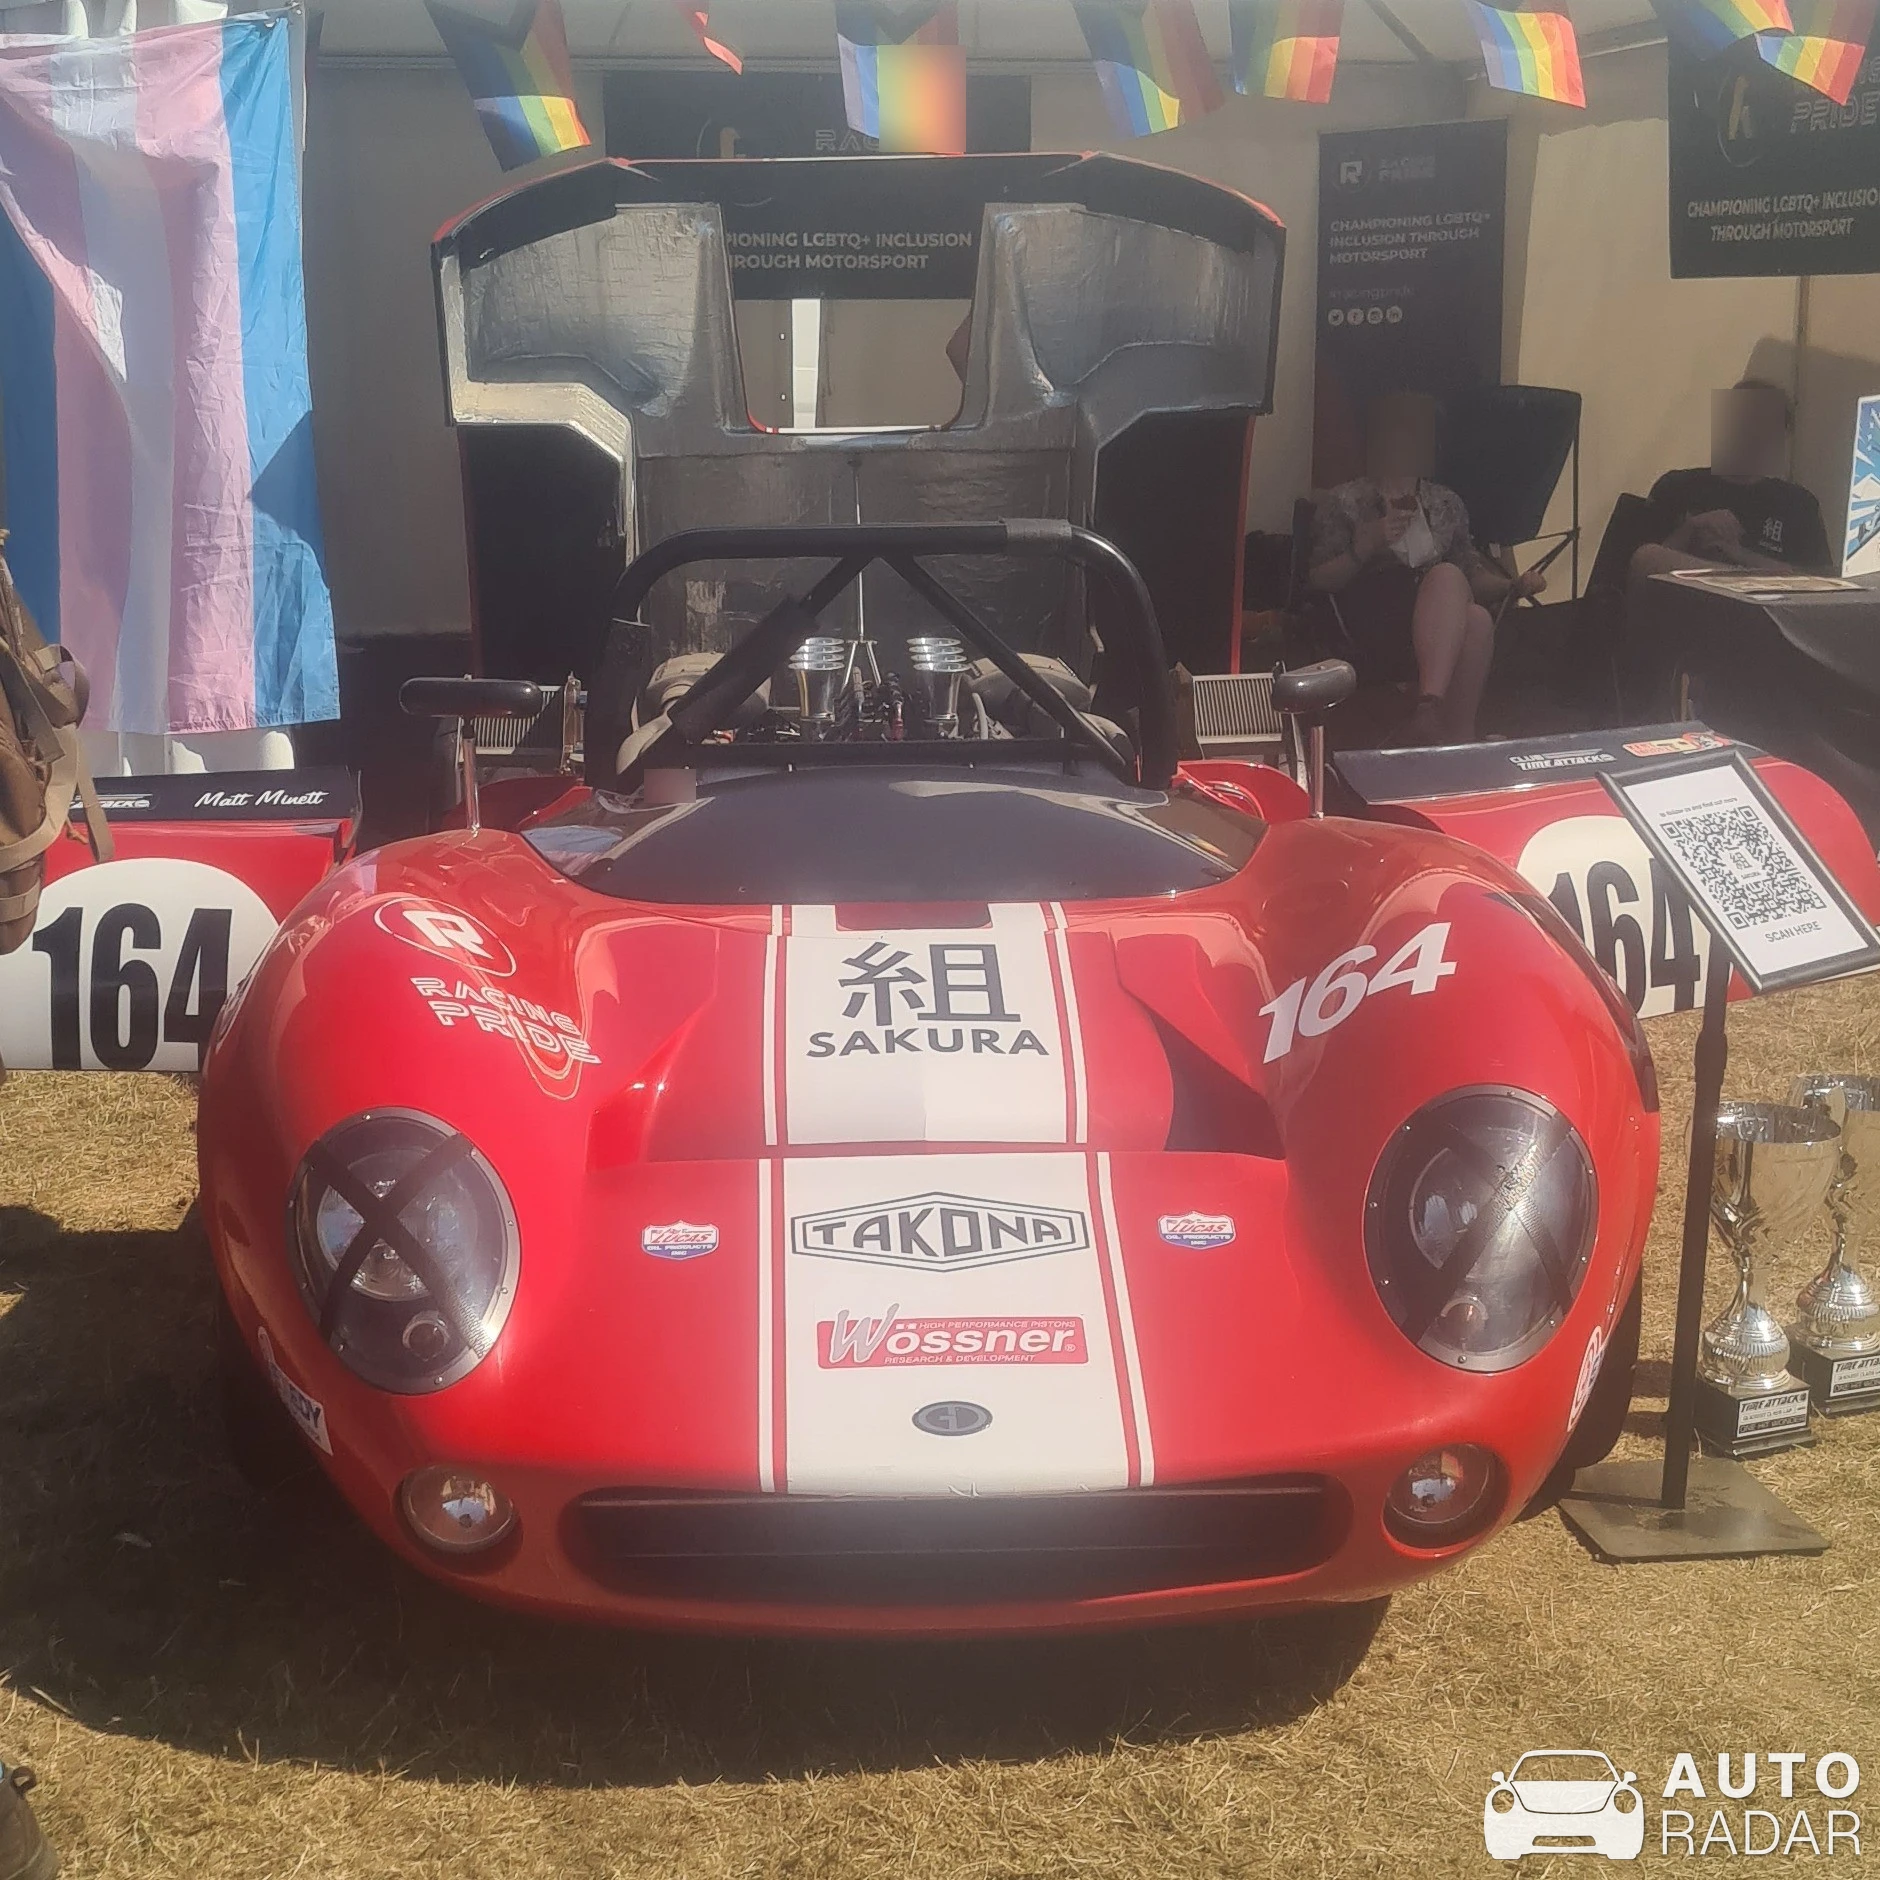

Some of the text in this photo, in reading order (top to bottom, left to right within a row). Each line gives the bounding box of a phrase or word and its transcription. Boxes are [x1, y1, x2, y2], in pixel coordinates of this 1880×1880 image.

[1687, 187, 1880, 218] CHAMPIONING LGBTQ+ INCLUSIO
[1330, 214, 1433, 232] CHAMPIONING
[1710, 217, 1855, 242] THROUGH MOTORSPORT
[803, 232, 871, 250] LGBTQ+
[876, 232, 972, 248] INCLUSION
[1328, 227, 1481, 249] INCLUSION THROUGH
[805, 254, 929, 269] MOTORSPORT
[1329, 248, 1428, 265] MOTORSPORT
[194, 789, 329, 808] Matt Minett
[1764, 920, 1823, 943] SCAN HERE
[32, 903, 232, 1071] 164
[838, 941, 1021, 1027] 組
[1258, 922, 1458, 1064] 164
[410, 977, 582, 1036] RACING
[427, 1000, 602, 1064] PRIDE
[806, 1027, 1050, 1058] SAKURA
[812, 1207, 1062, 1257] TAKONA
[919, 1320, 1076, 1330] HIGH PERFORMANCE PISTONS
[884, 1355, 943, 1364] RESEARCH
[955, 1354, 1036, 1362] DEVELOPMENT
[1764, 1393, 1800, 1408] ATTACK
